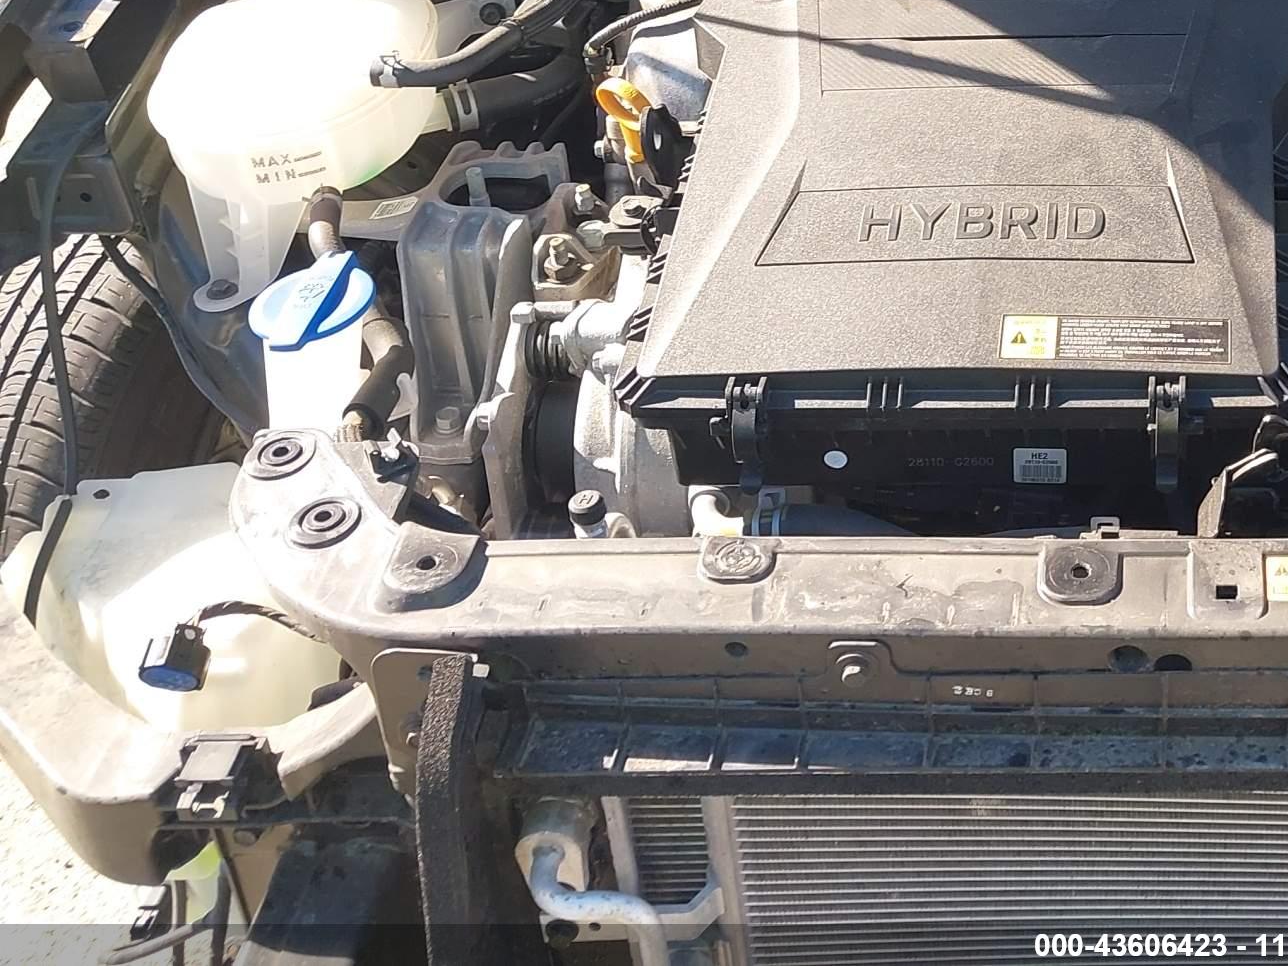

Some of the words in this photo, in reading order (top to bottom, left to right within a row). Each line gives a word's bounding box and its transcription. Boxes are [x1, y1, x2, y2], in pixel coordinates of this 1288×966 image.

[251, 153, 292, 168] MAX
[256, 169, 297, 184] MIN
[858, 201, 1107, 242] HYBRID
[1031, 452, 1049, 460] HE2
